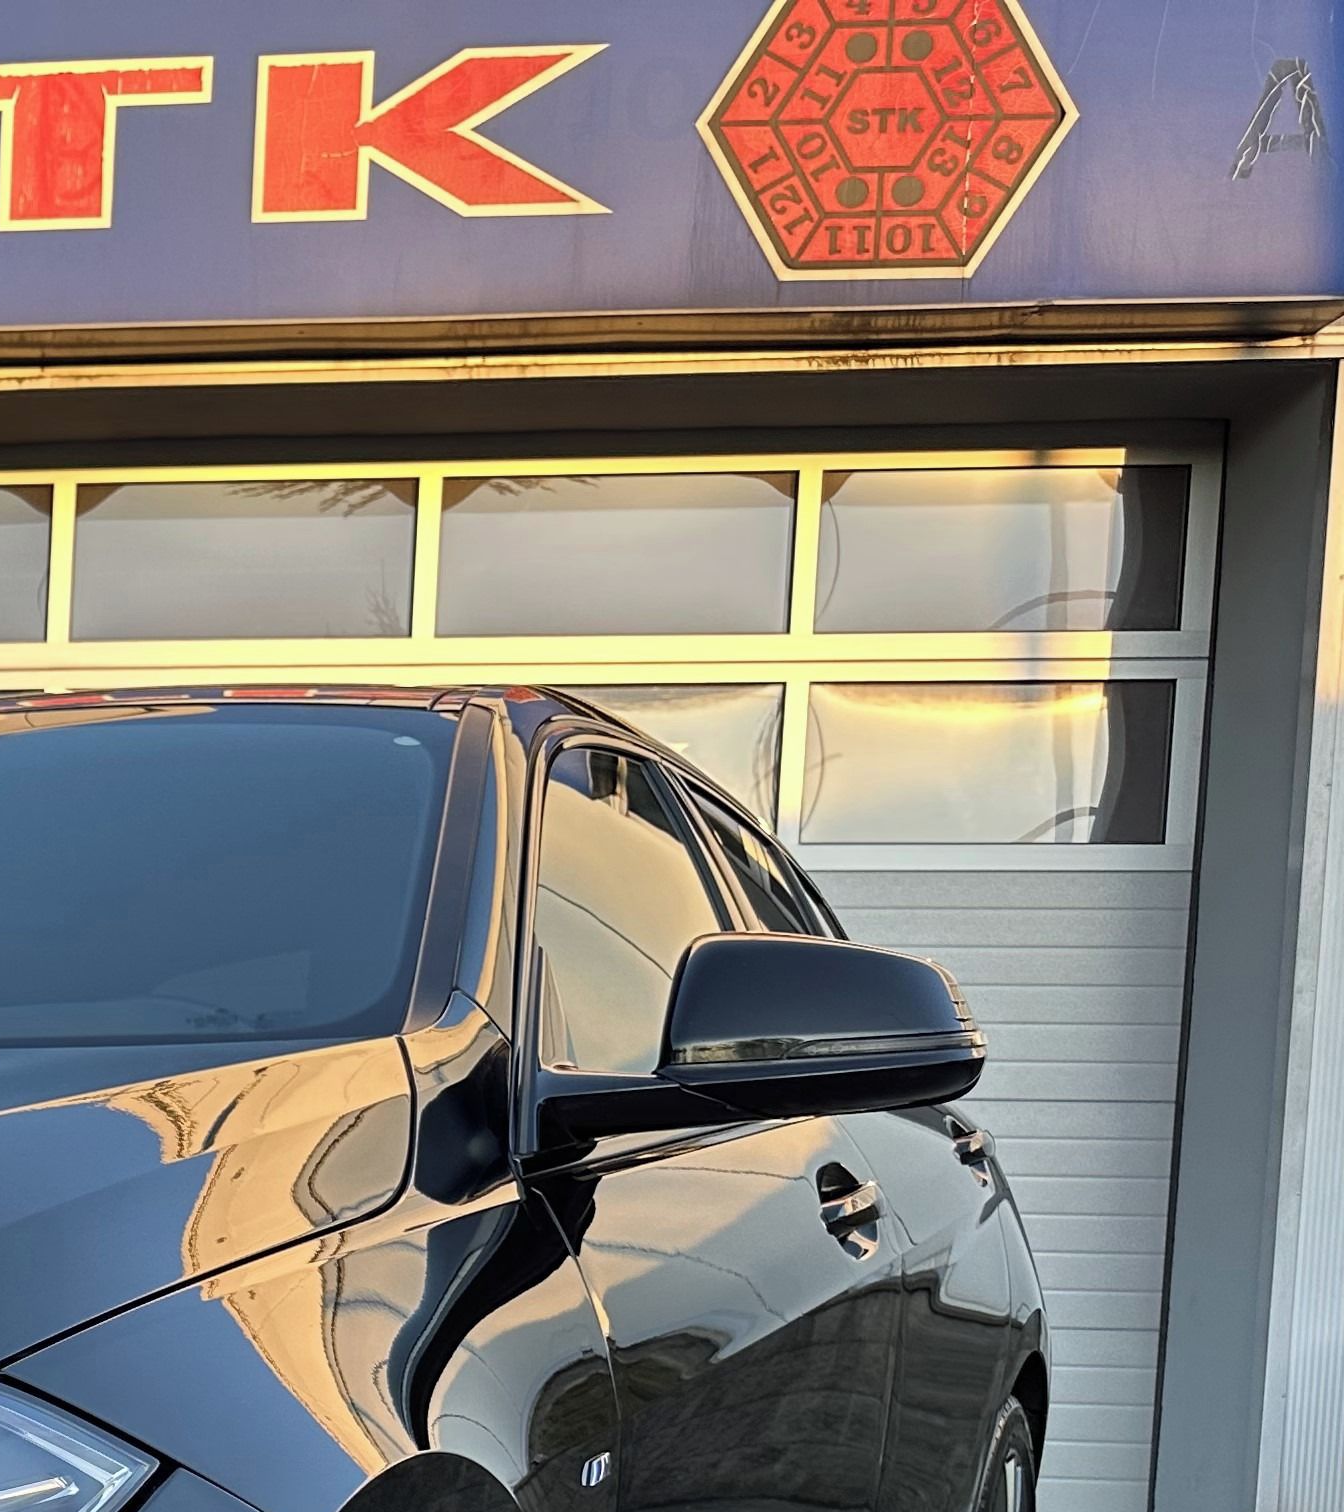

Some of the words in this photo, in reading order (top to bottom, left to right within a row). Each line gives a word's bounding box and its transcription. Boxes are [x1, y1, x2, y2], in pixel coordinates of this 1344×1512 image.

[785, 21, 816, 50] 3
[747, 76, 780, 107] 2
[998, 66, 1033, 94] 7
[846, 107, 927, 135] STK
[992, 135, 1024, 165] 8
